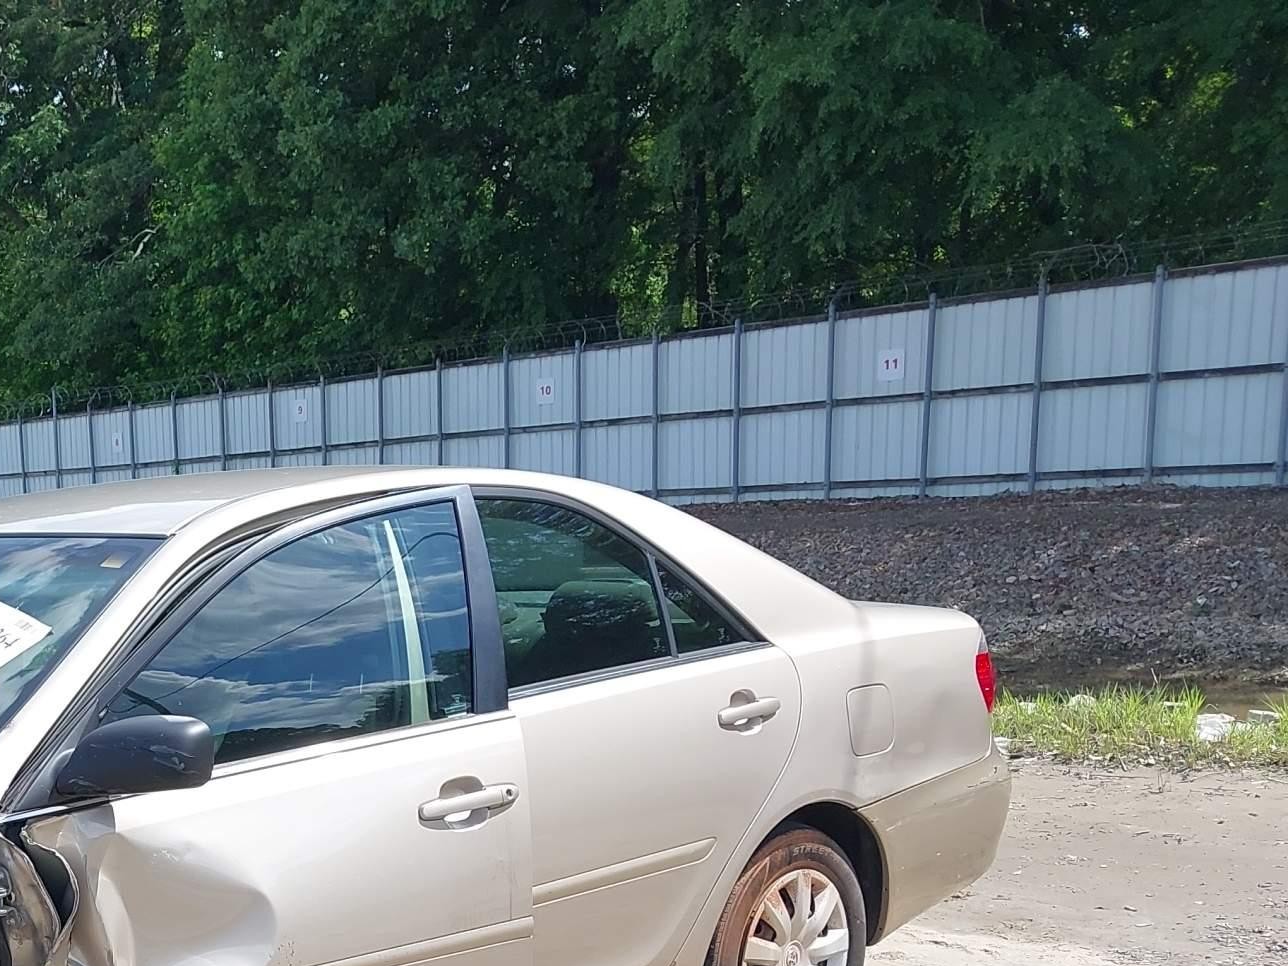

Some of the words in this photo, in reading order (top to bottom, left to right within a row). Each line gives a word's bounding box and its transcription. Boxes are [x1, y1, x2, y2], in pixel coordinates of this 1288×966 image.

[884, 358, 898, 370] 11
[540, 385, 552, 396] 10
[297, 405, 303, 415] 9
